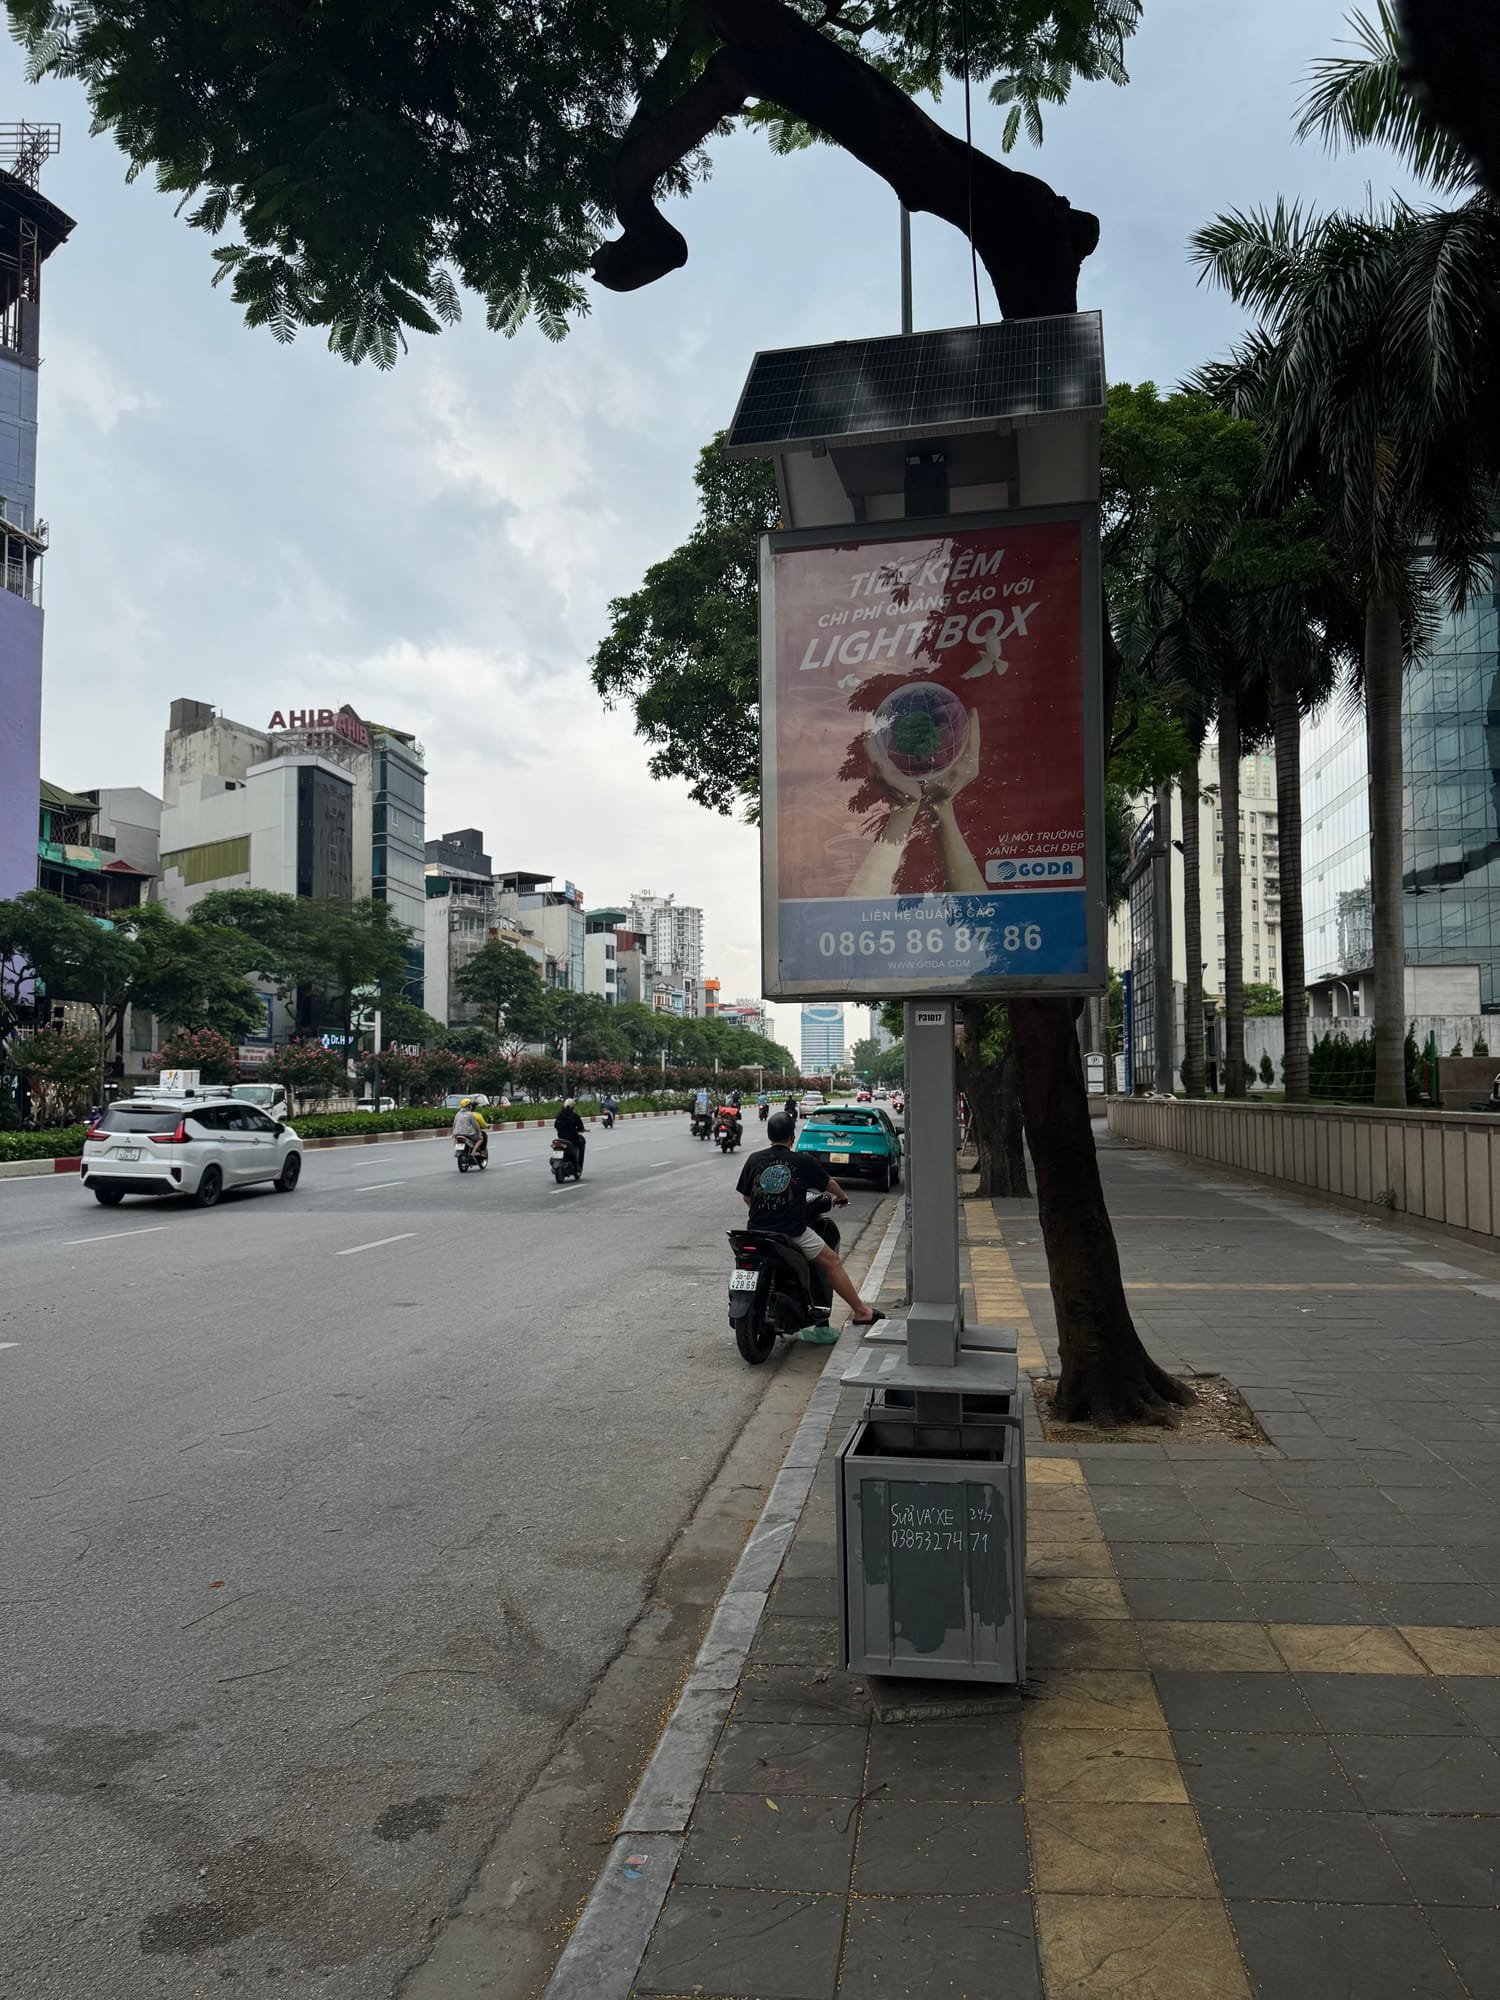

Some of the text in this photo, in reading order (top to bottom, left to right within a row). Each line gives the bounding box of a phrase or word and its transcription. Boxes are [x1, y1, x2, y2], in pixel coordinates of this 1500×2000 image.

[818, 610, 848, 628] CHI
[852, 603, 881, 624] PHÍ
[957, 584, 996, 605] CÁO
[1003, 576, 1036, 598] VỚI
[800, 602, 1041, 671] LIGHT BOX
[268, 709, 335, 729] AHIB
[1011, 831, 1033, 842] MÔI
[985, 846, 1018, 856] XANH
[1027, 844, 1058, 856] SẠCH
[1061, 842, 1085, 854] ĐẸP
[1018, 861, 1073, 877] GODA
[862, 908, 891, 922] LIÊN
[895, 911, 910, 922] HỆ
[819, 924, 1042, 957] 0865 86 87 86
[888, 958, 971, 970] WWW.GODA.COM
[918, 1013, 942, 1022] P31017
